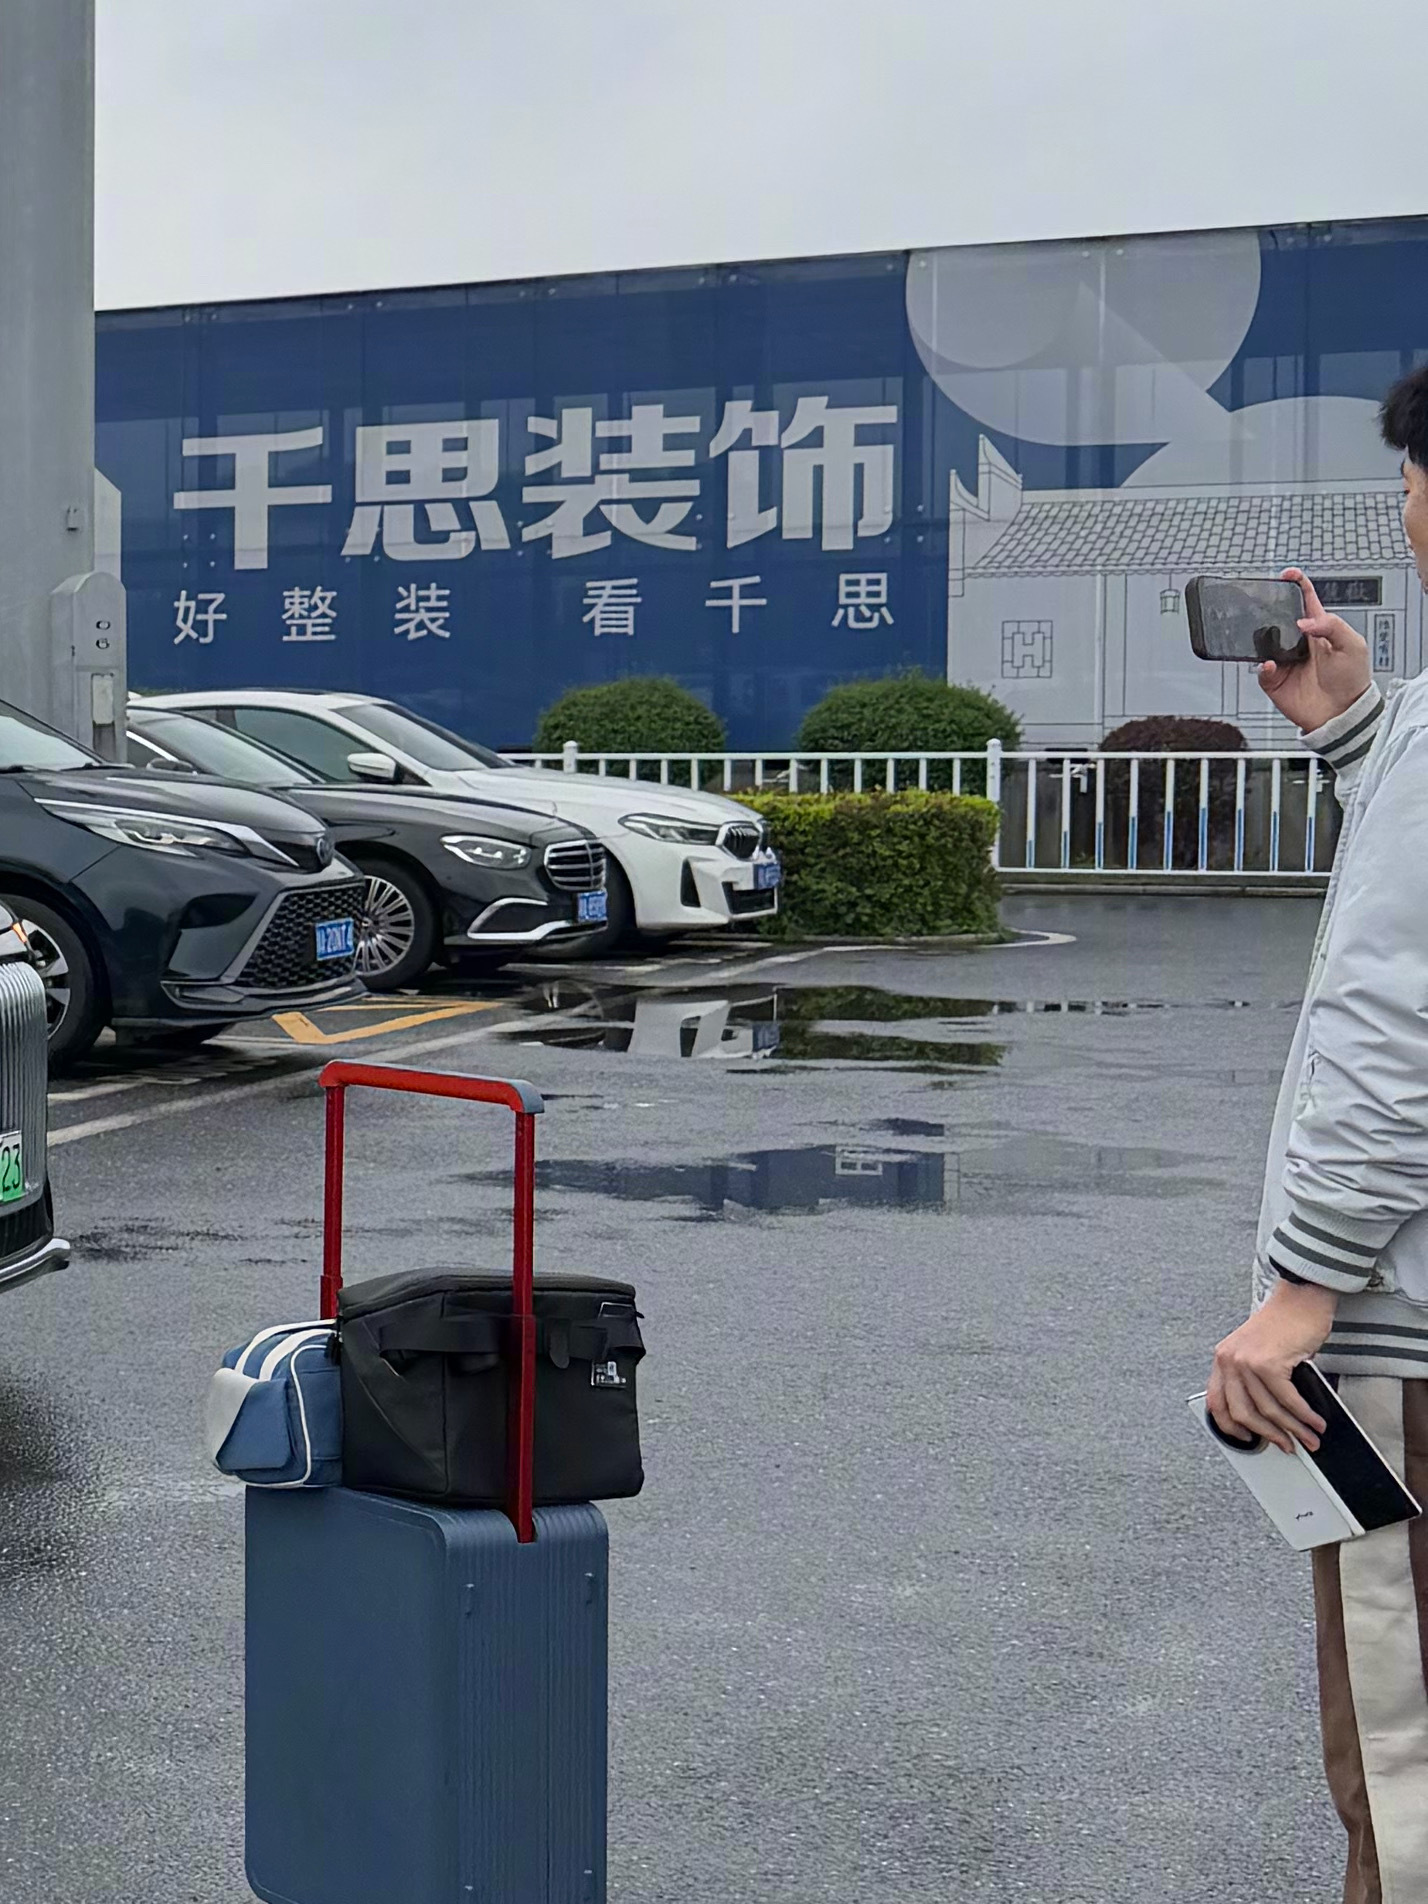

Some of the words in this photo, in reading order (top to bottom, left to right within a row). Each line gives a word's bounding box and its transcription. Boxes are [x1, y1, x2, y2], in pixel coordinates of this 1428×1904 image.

[173, 395, 898, 570] 千思装饰
[173, 582, 452, 645] 好整装
[582, 571, 895, 636] 看千思
